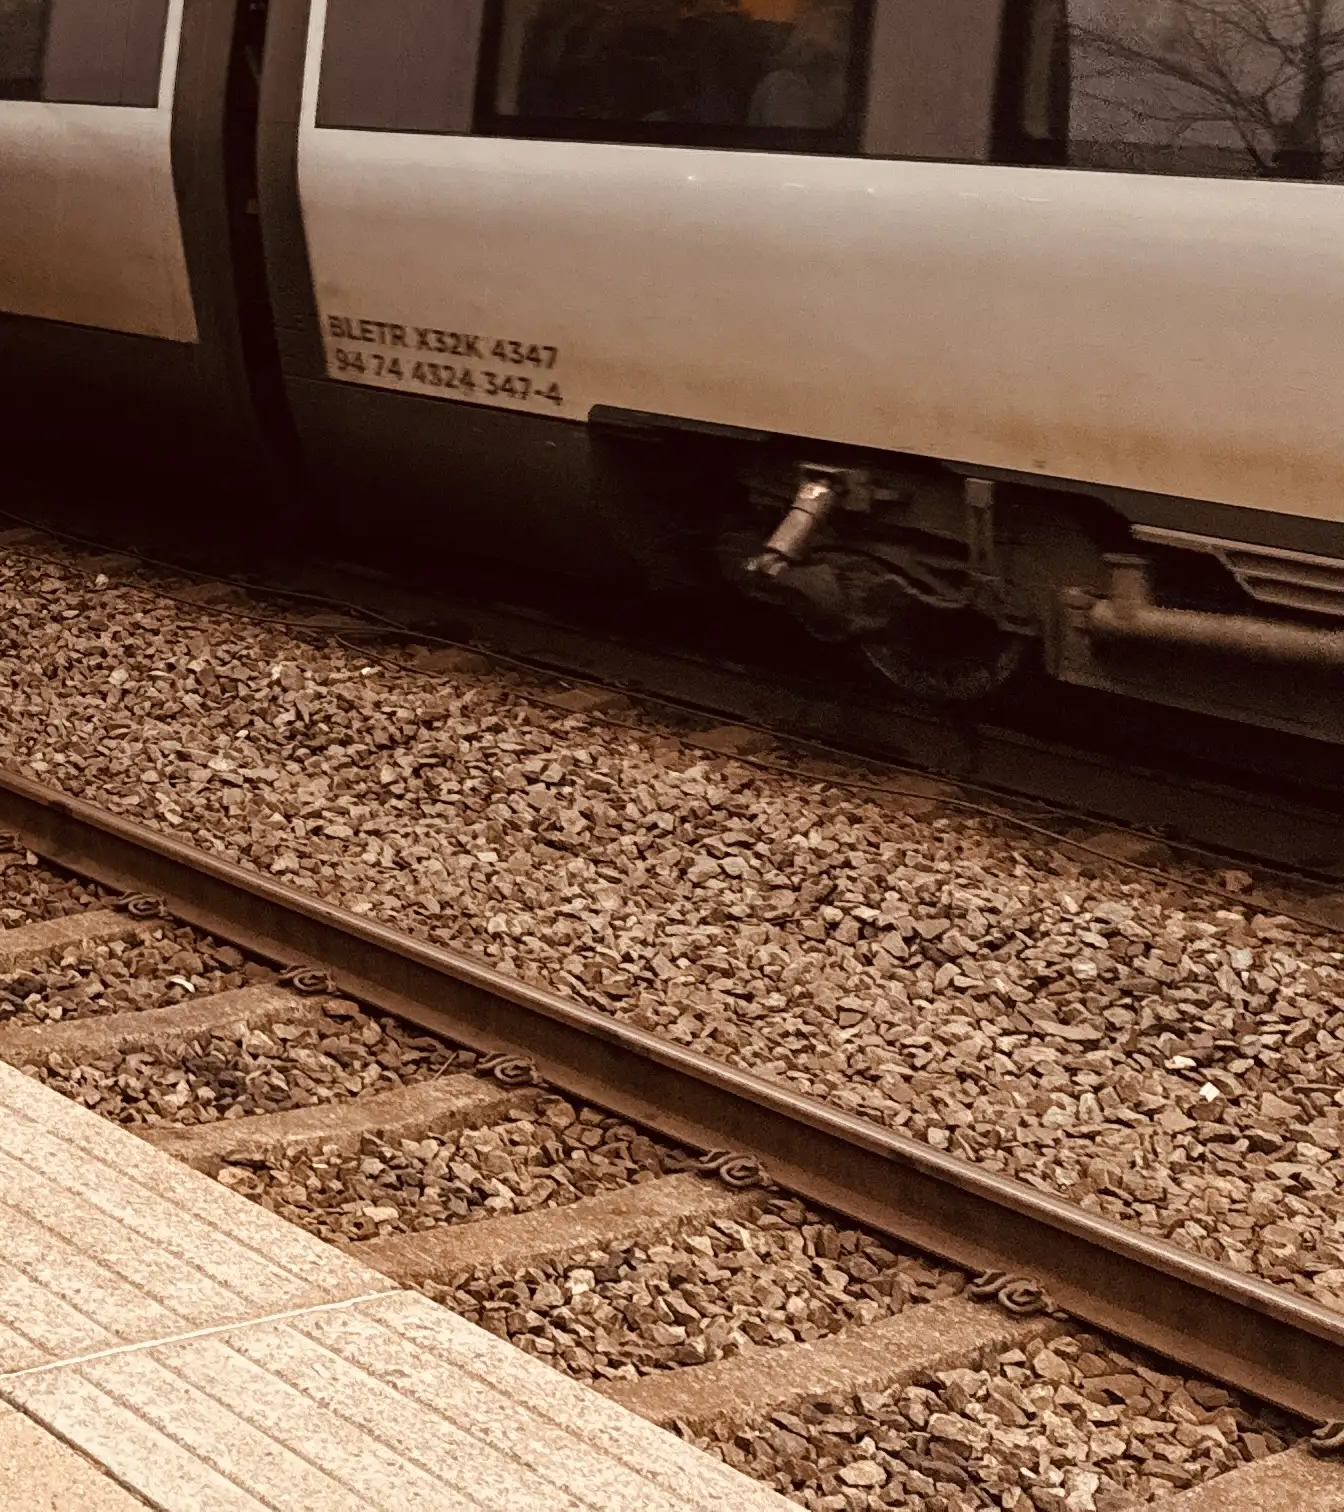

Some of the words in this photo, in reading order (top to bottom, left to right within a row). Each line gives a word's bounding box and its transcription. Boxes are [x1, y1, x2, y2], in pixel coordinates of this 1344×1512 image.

[335, 347, 366, 375] 94
[372, 354, 404, 381] 74
[412, 361, 477, 390] 4324
[479, 370, 564, 405] 347-4
[491, 340, 559, 369] 4347
